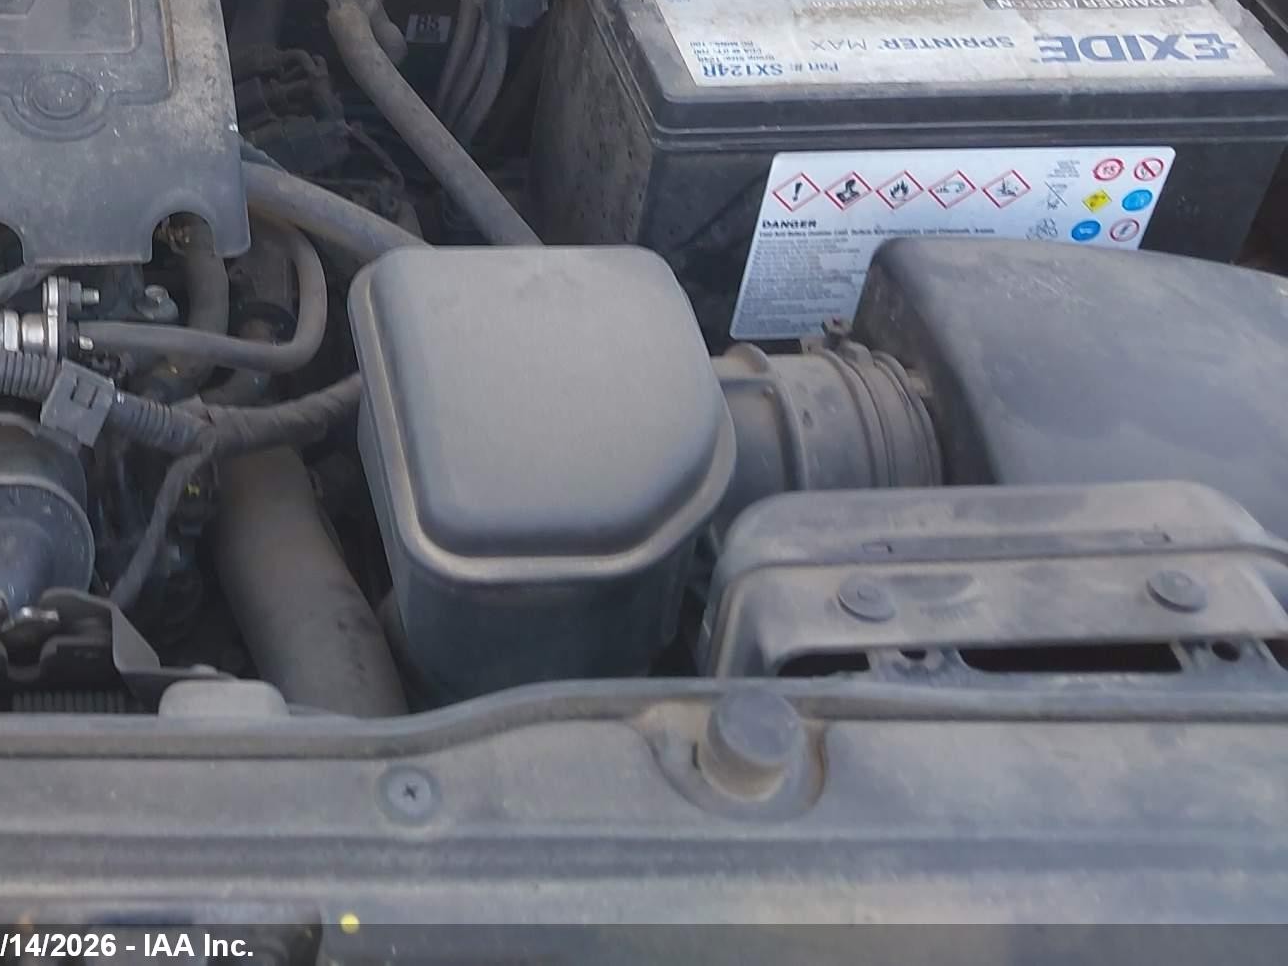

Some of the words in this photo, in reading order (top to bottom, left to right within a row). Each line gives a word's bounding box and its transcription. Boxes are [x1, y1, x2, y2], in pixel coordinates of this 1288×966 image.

[811, 38, 867, 51] MAX
[884, 36, 1015, 50] SPRINTER
[1033, 33, 1237, 63] EXIDE
[703, 61, 784, 78] SX124R
[808, 61, 840, 73] Part
[762, 219, 817, 229] DANGER
